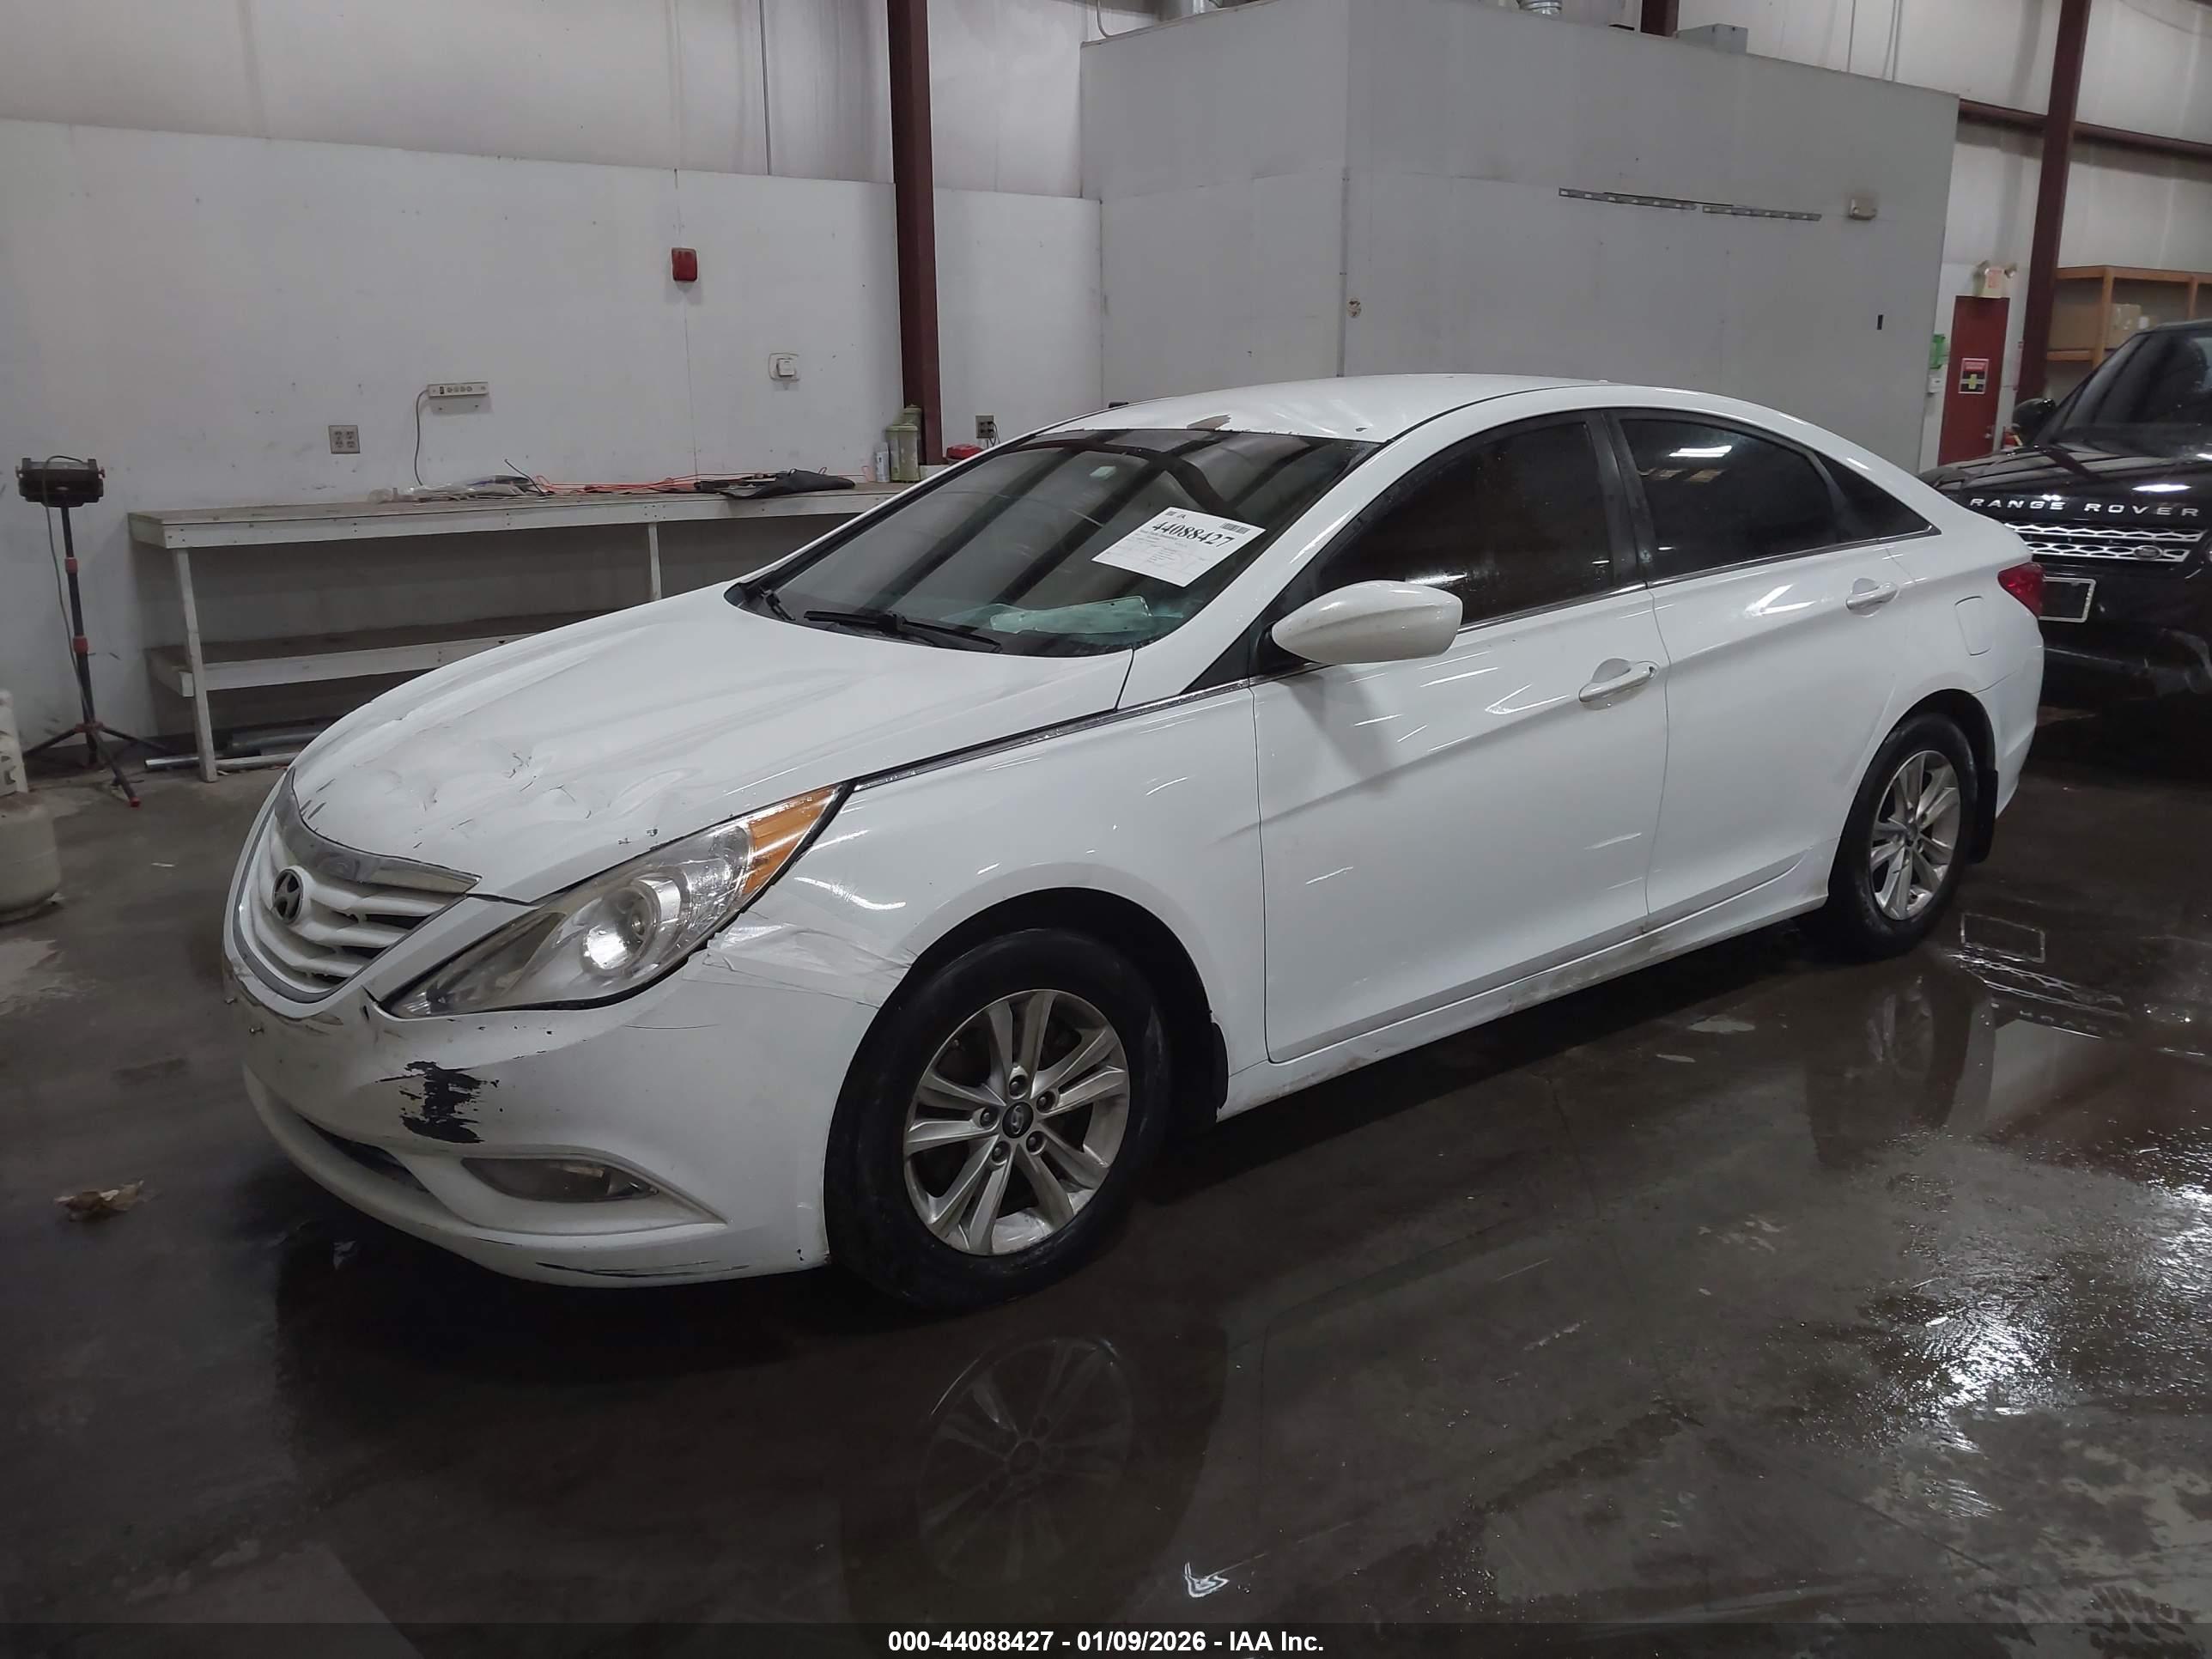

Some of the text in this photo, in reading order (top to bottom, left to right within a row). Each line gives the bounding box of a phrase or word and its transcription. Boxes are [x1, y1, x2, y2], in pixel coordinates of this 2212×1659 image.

[1969, 497, 2200, 517] RANGE ROVER
[1152, 521, 1236, 548] 44088427
